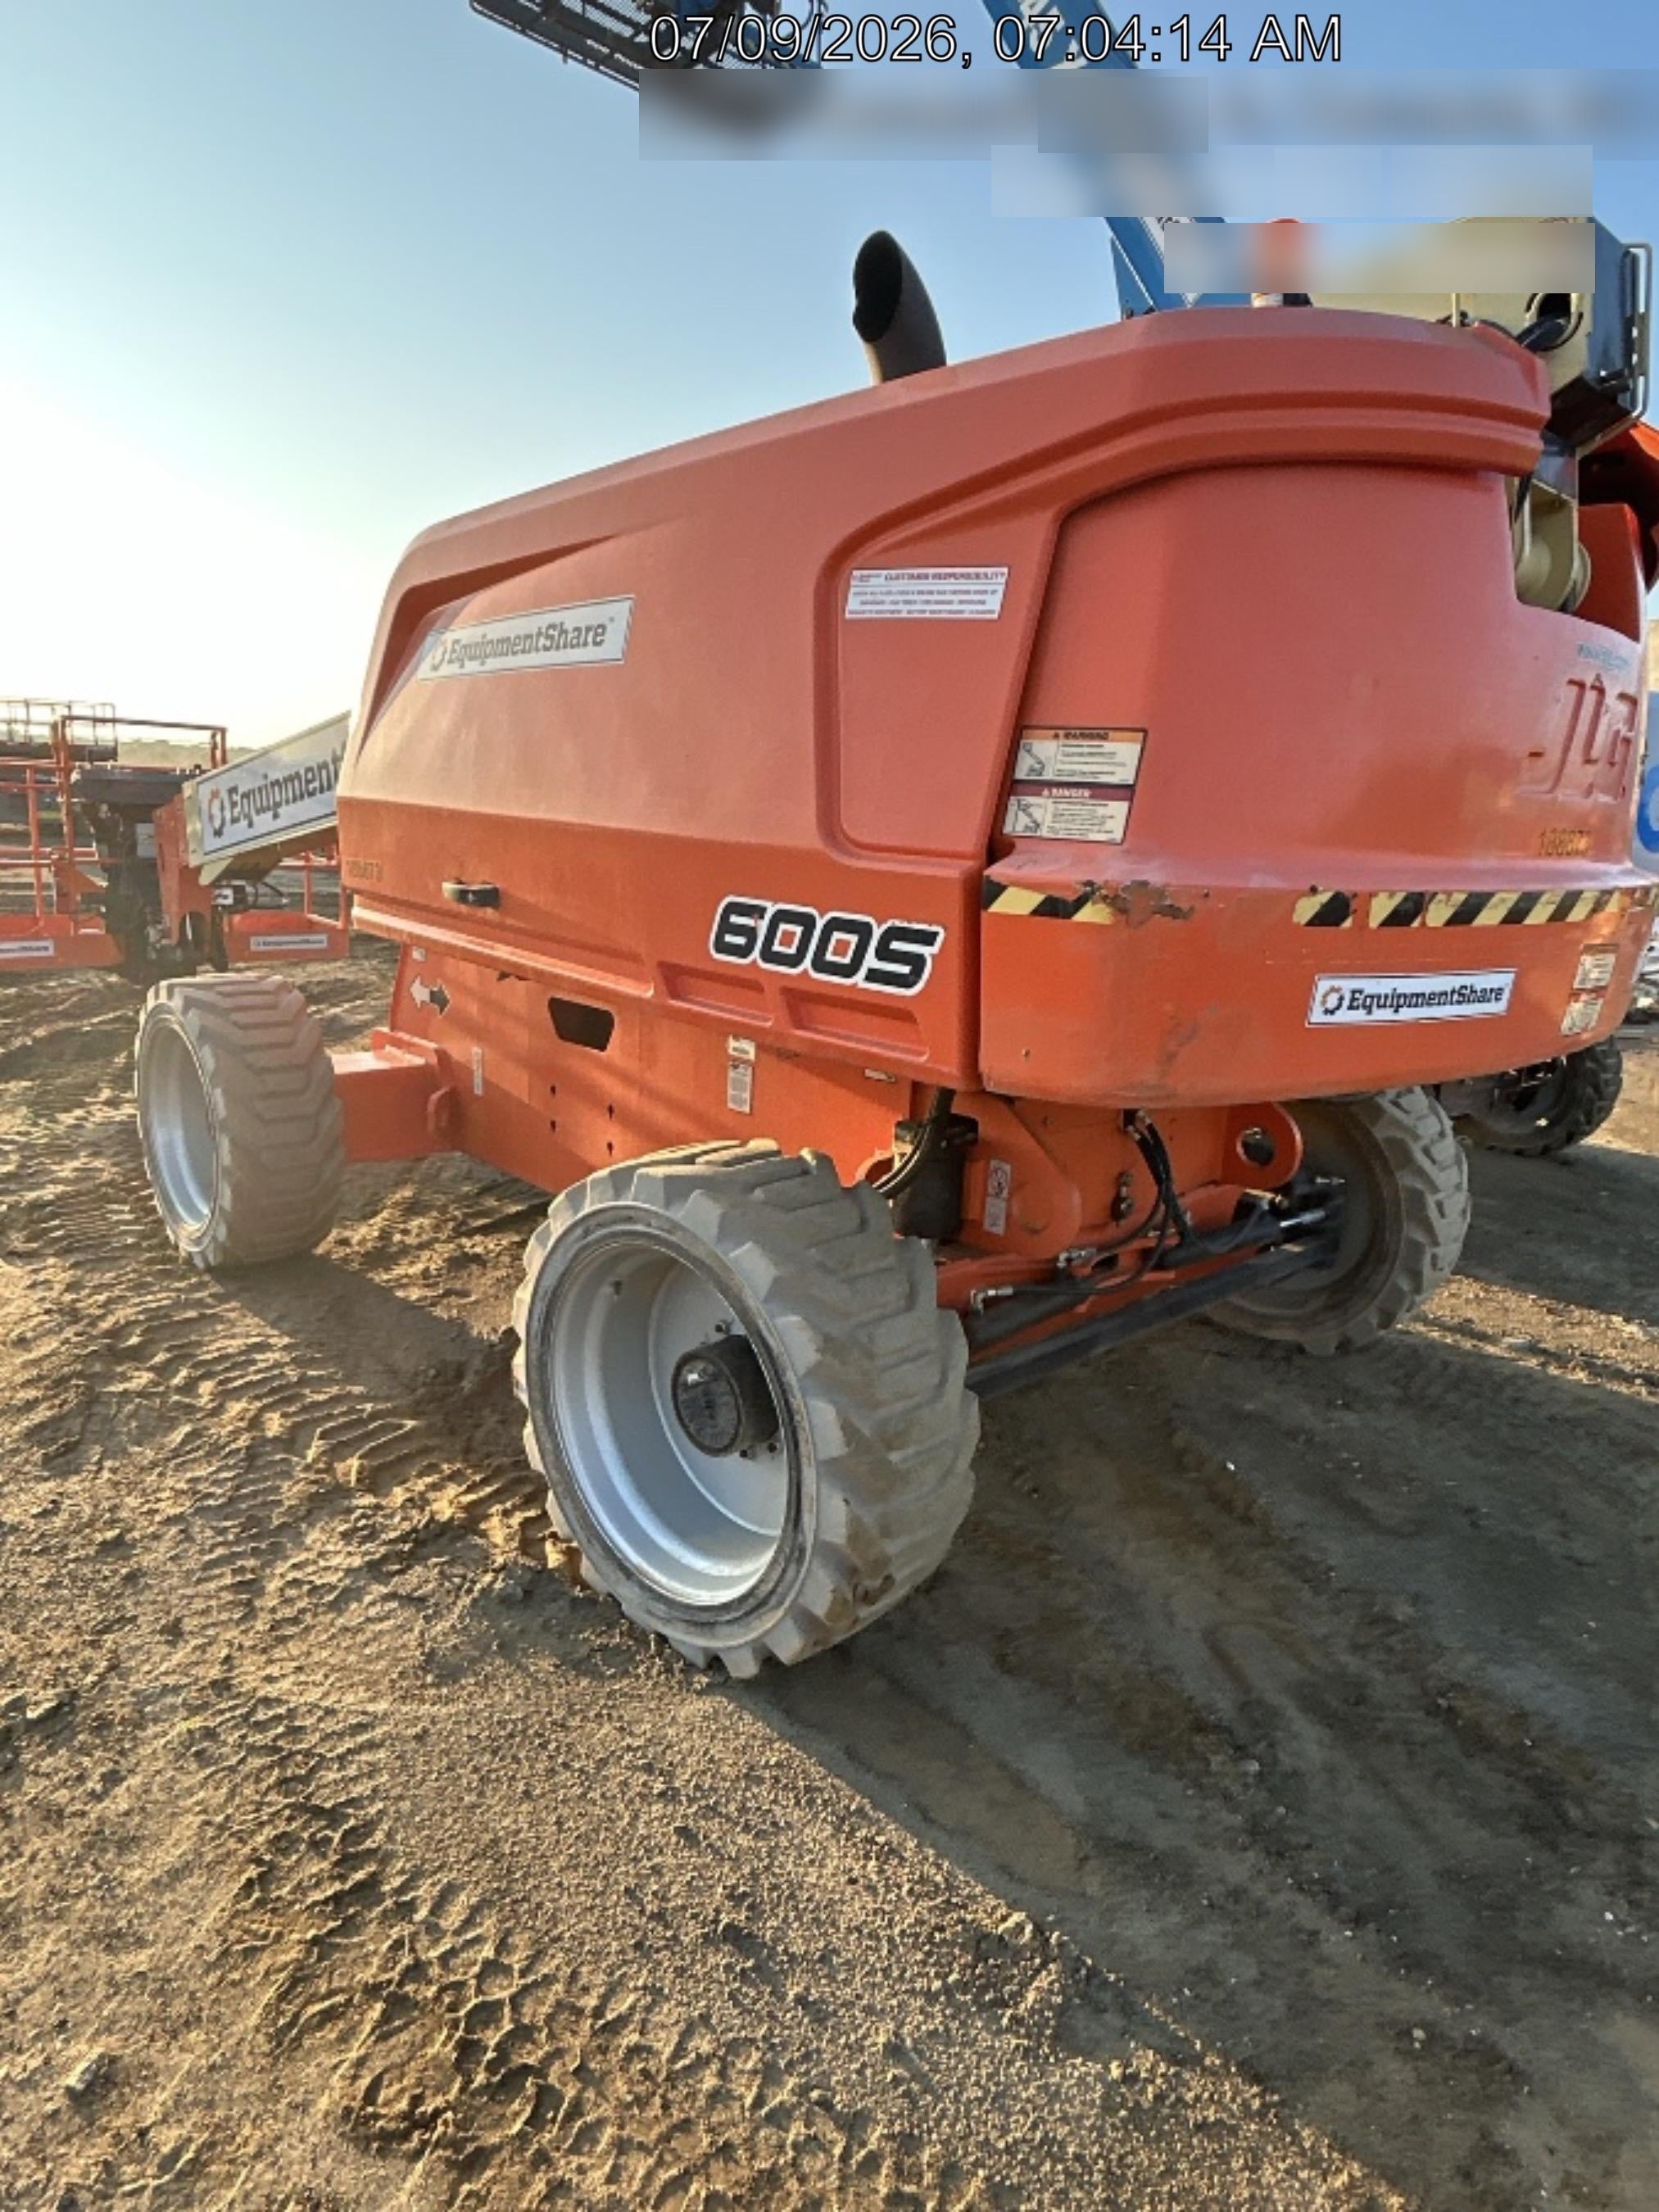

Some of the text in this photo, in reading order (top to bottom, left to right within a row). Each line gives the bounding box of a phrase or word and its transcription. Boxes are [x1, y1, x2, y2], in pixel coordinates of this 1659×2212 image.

[448, 622, 607, 668] EquipmentShare
[228, 740, 346, 828] Equipment
[710, 897, 944, 995] 600S
[1347, 984, 1505, 1015] EquipmentShare
